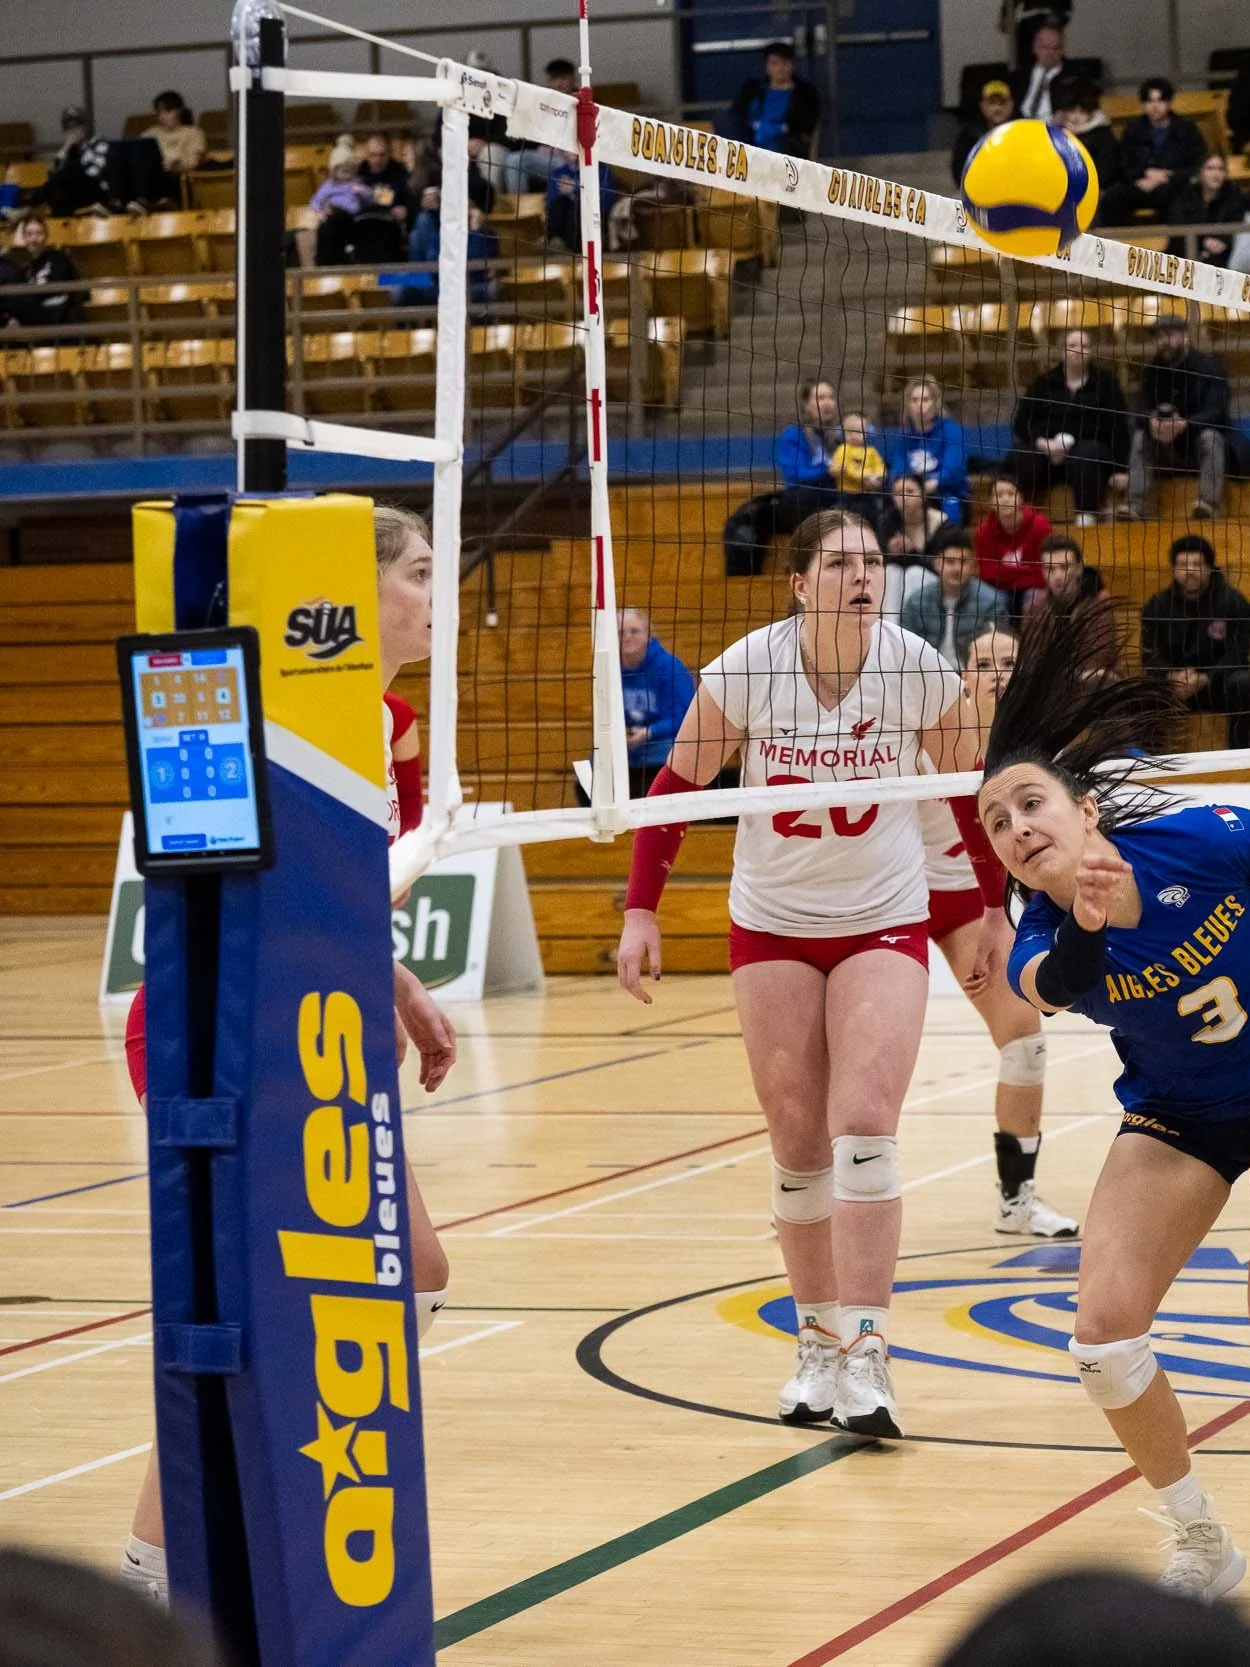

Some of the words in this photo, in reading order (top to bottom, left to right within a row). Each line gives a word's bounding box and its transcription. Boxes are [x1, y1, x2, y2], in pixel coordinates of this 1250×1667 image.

[759, 740, 897, 768] MEMORIAL
[1170, 894, 1246, 976] BLEUES
[1177, 975, 1248, 1045] 3
[371, 1092, 402, 1287] bleues
